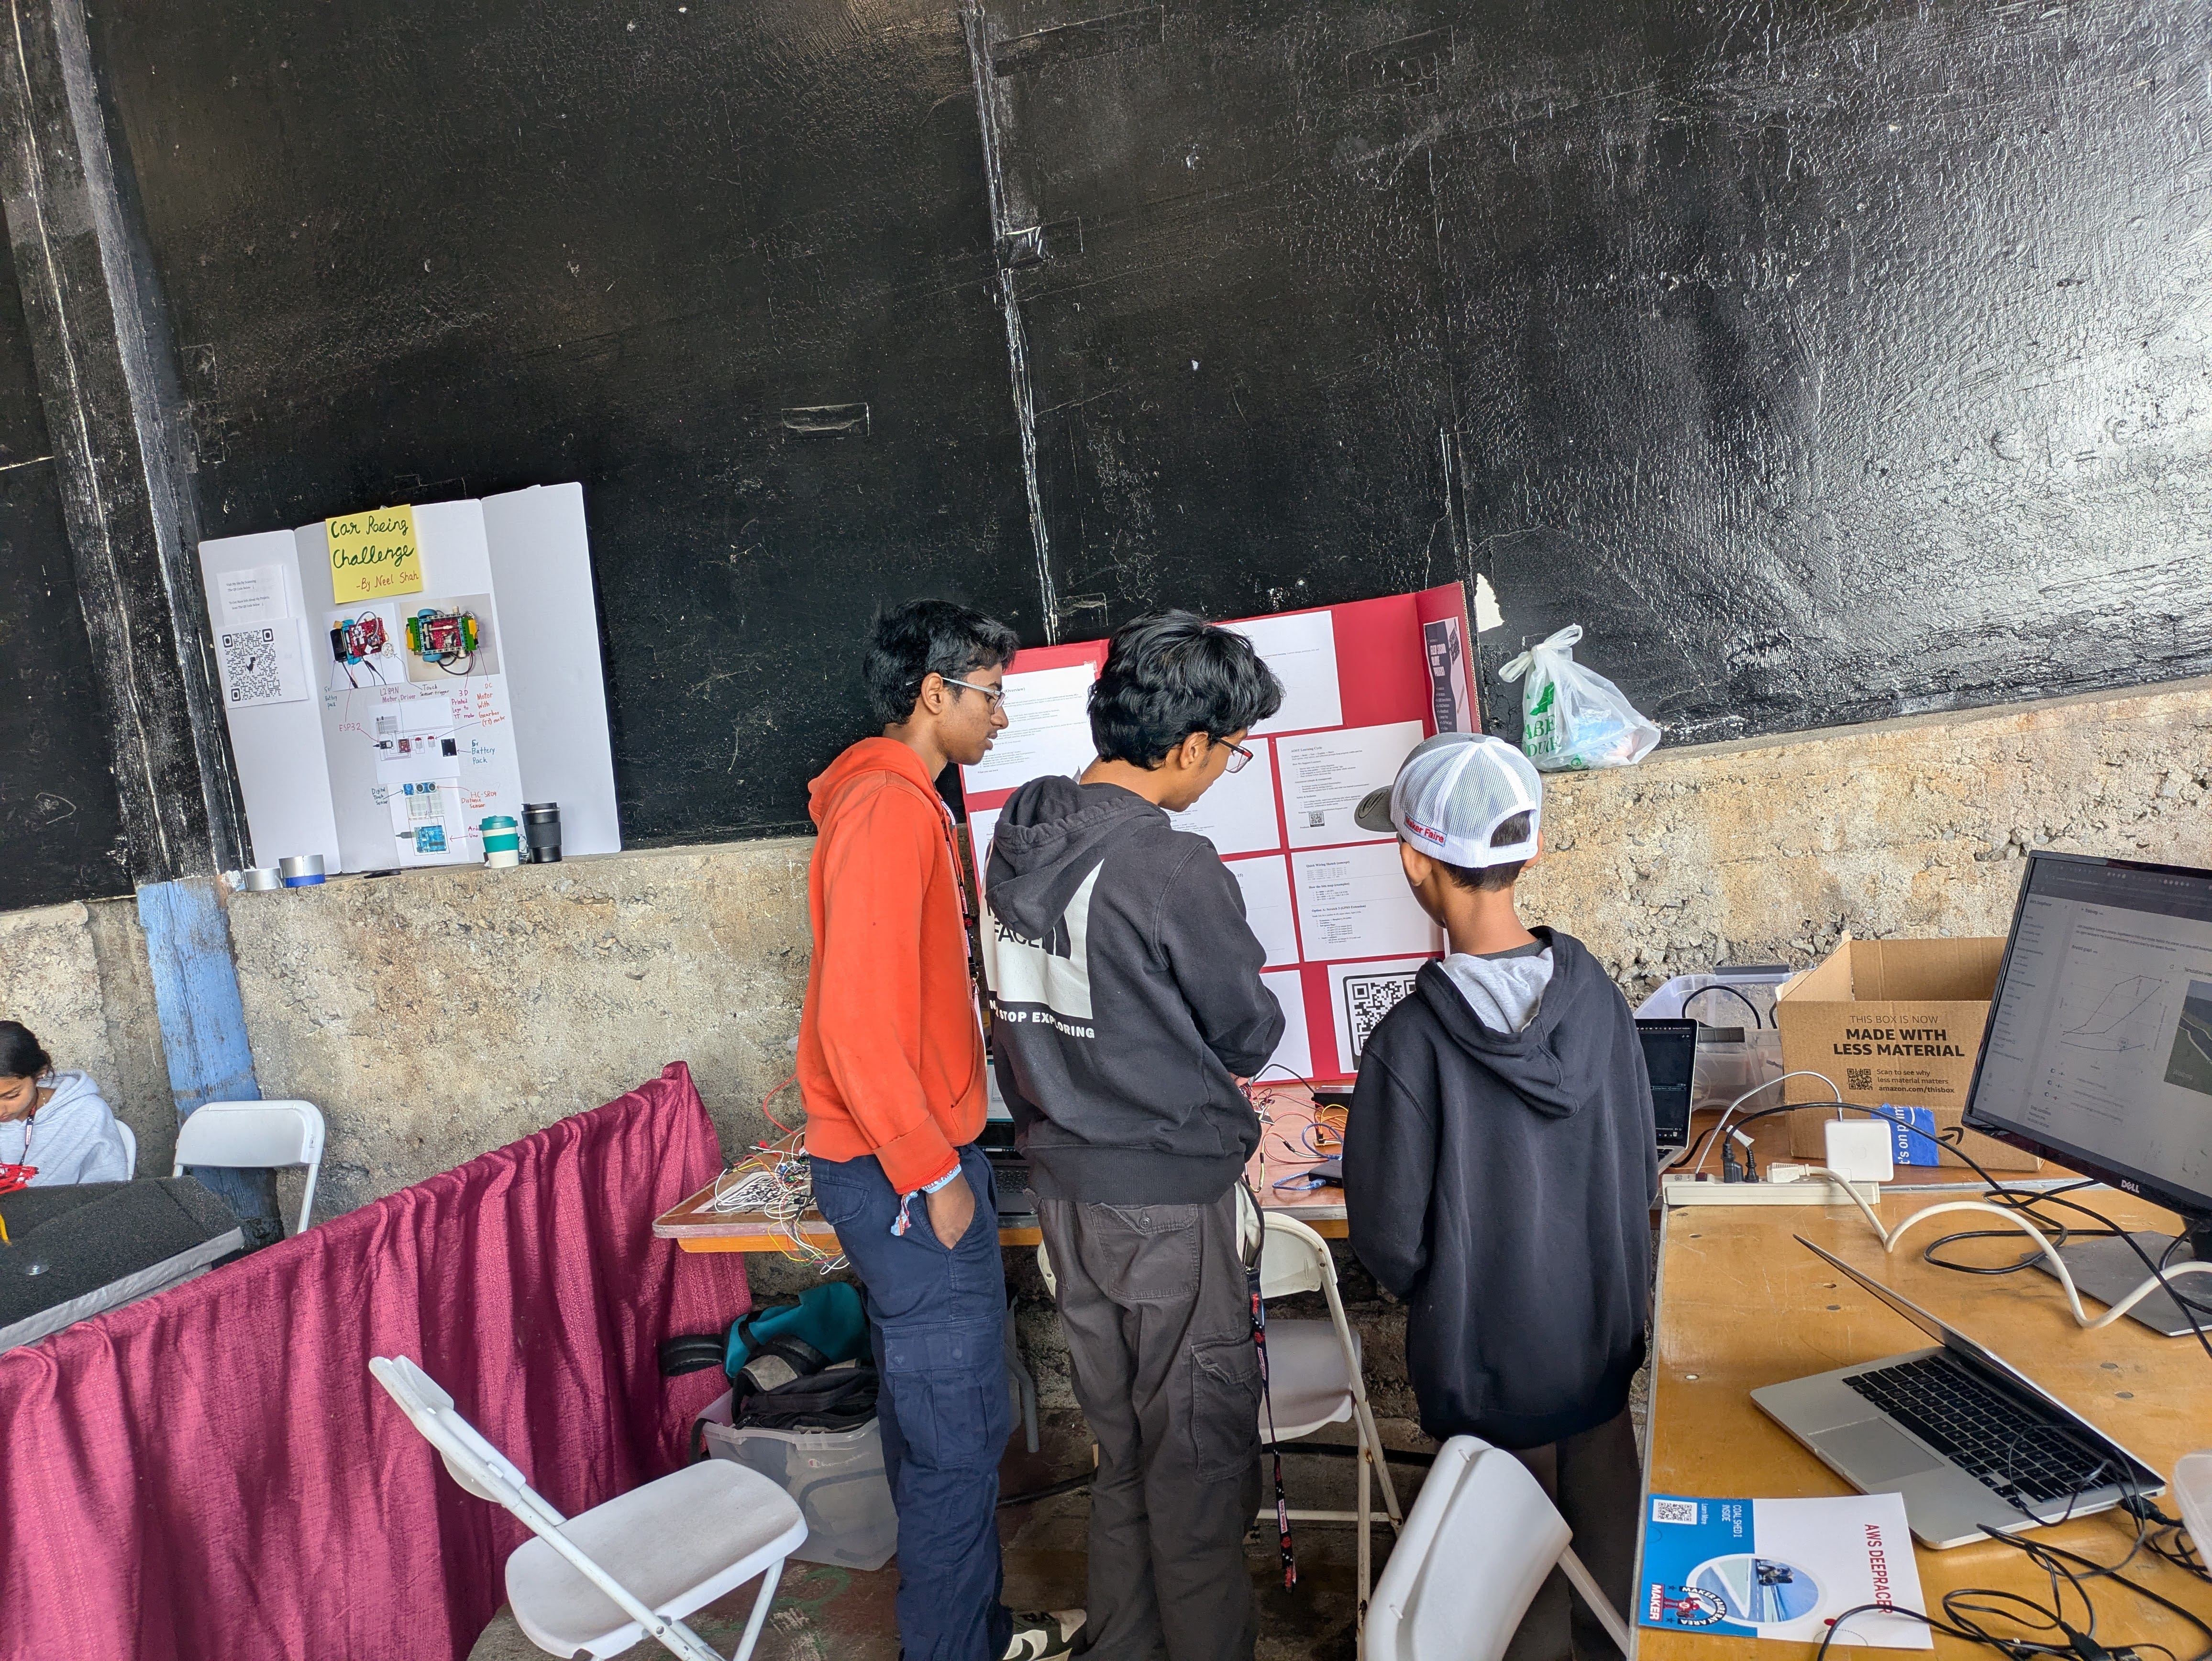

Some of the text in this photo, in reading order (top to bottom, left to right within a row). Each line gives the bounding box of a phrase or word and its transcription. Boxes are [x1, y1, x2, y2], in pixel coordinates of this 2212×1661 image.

[331, 521, 360, 538] Car
[333, 545, 414, 568] Challenge
[375, 574, 394, 587] Neel
[400, 570, 419, 583] Shah
[477, 701, 490, 709] With
[478, 710, 499, 718] Gearbox
[339, 723, 361, 731] ESP32
[471, 747, 495, 755] Battery
[472, 757, 487, 765] Pack
[1405, 815, 1444, 843] Maker Faire
[999, 1009, 1095, 1039] STOP EXPLORING
[1846, 1029, 1947, 1041] MADE WITH
[1833, 1043, 1965, 1057] LESS MATERIAL
[1898, 1135, 1909, 1149] on
[2121, 1179, 2139, 1194] DELL
[1701, 1504, 1709, 1525] Learn More
[1722, 1505, 1730, 1522] INSIDE
[1733, 1505, 1742, 1518] COAL
[1733, 1518, 1742, 1533] SHED
[1865, 1524, 1882, 1548] AWS
[1682, 1587, 1716, 1599] MAKER
[1649, 1584, 1661, 1620] MAKER
[1713, 1598, 1725, 1614] FAIRE
[1707, 1613, 1723, 1624] BAY
